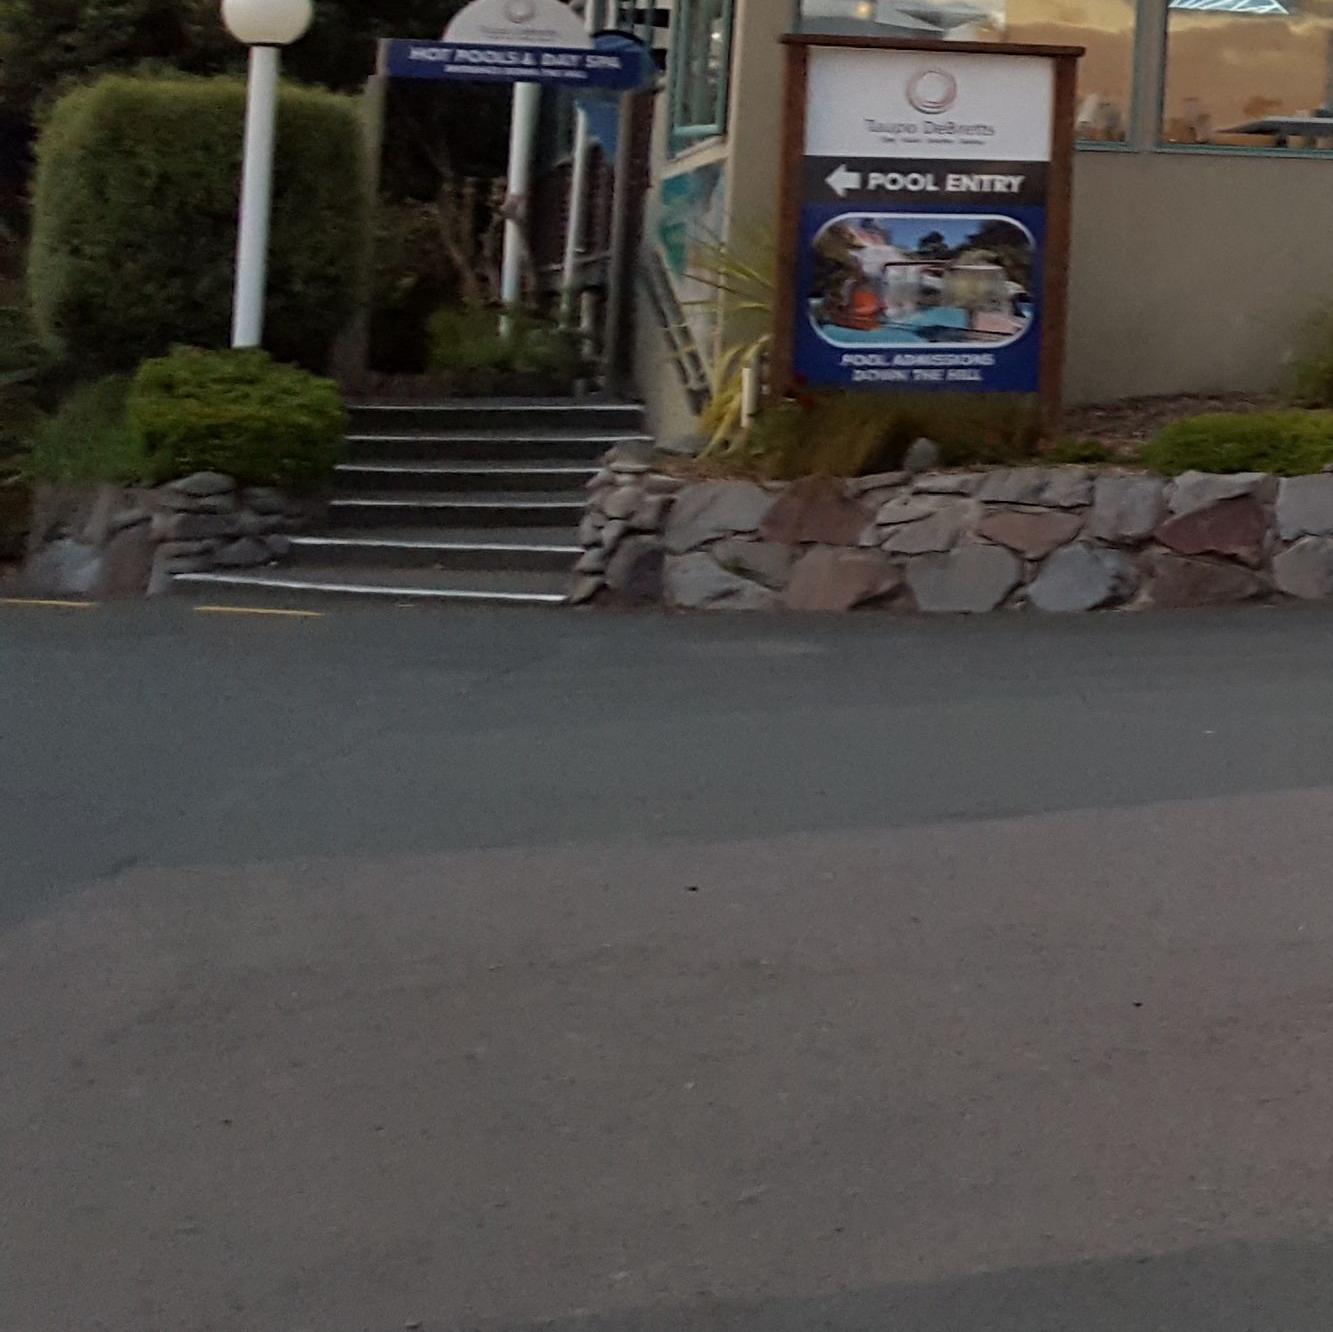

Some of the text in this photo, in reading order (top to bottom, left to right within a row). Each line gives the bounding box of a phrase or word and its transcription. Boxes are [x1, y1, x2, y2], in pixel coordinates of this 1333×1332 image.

[408, 45, 451, 62] HOT
[452, 48, 518, 65] POOLS
[540, 52, 582, 68] DAY
[867, 171, 1026, 194] POOL ENTRY
